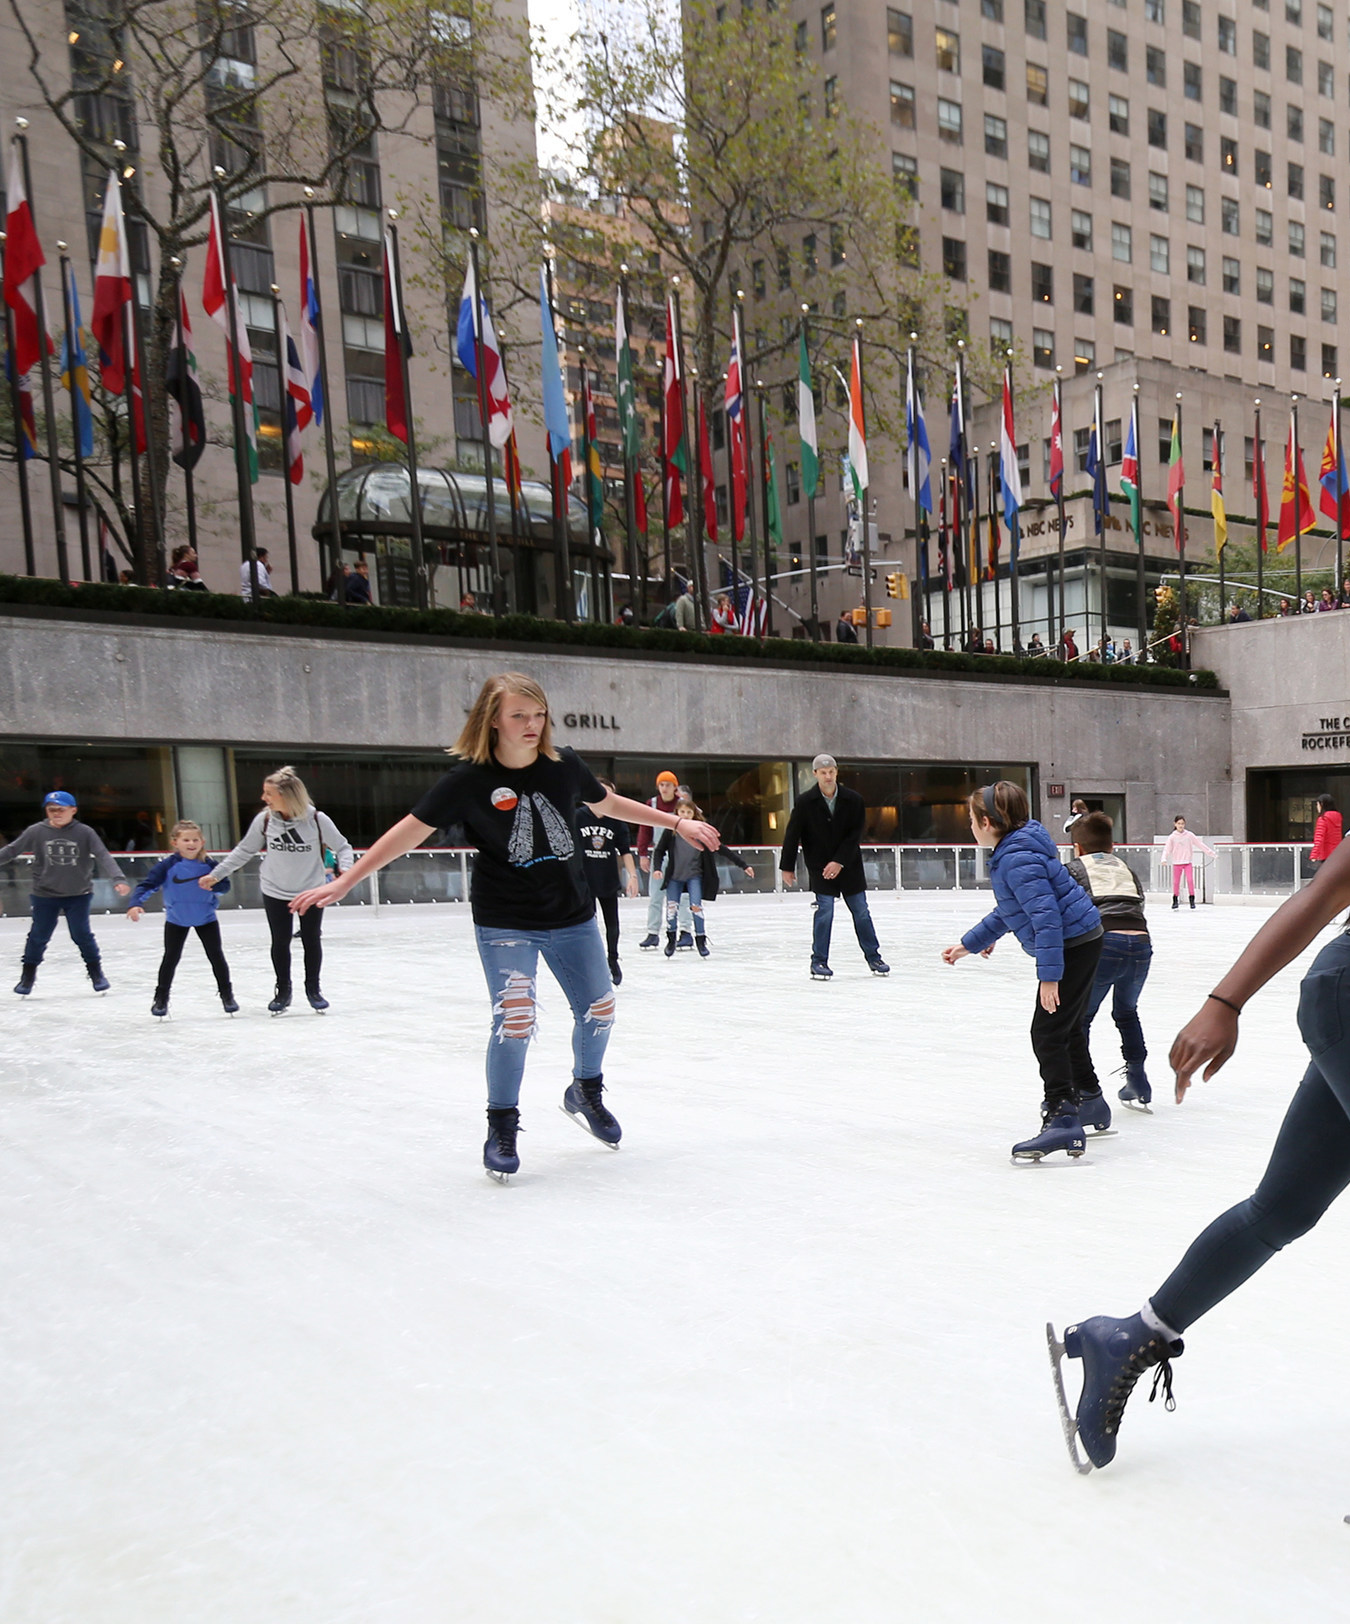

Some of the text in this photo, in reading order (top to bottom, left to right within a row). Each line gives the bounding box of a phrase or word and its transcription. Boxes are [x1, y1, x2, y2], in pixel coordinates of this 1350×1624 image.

[1027, 515, 1074, 538] NBC NES
[1125, 518, 1151, 536] NC
[563, 714, 621, 730] GRILL
[1319, 718, 1340, 730] THE
[580, 826, 615, 840] NYPD
[269, 841, 312, 853] adidas
